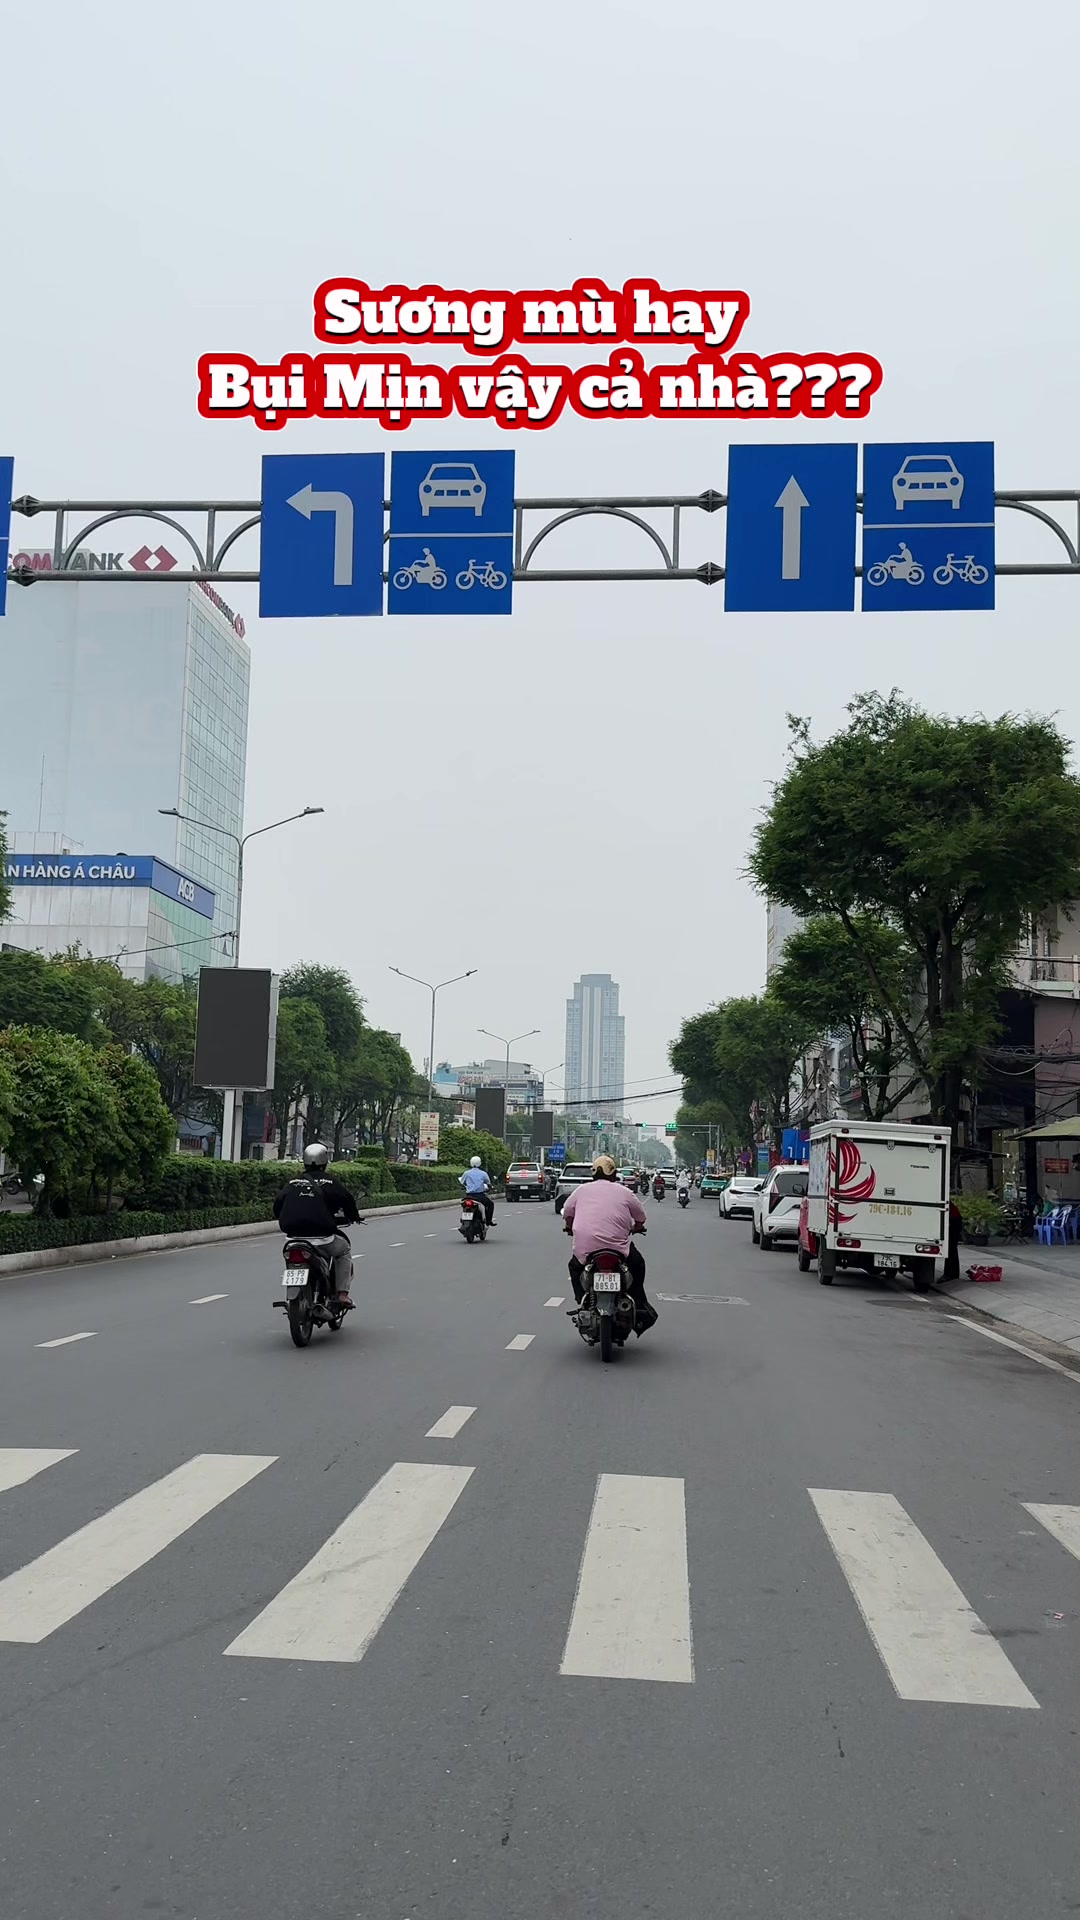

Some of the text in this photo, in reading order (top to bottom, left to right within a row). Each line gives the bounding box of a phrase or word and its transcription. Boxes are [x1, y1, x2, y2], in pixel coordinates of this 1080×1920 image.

[23, 861, 71, 878] HÀNG
[73, 862, 86, 879] Á
[88, 862, 136, 879] CHÂU
[177, 876, 195, 902] ACB
